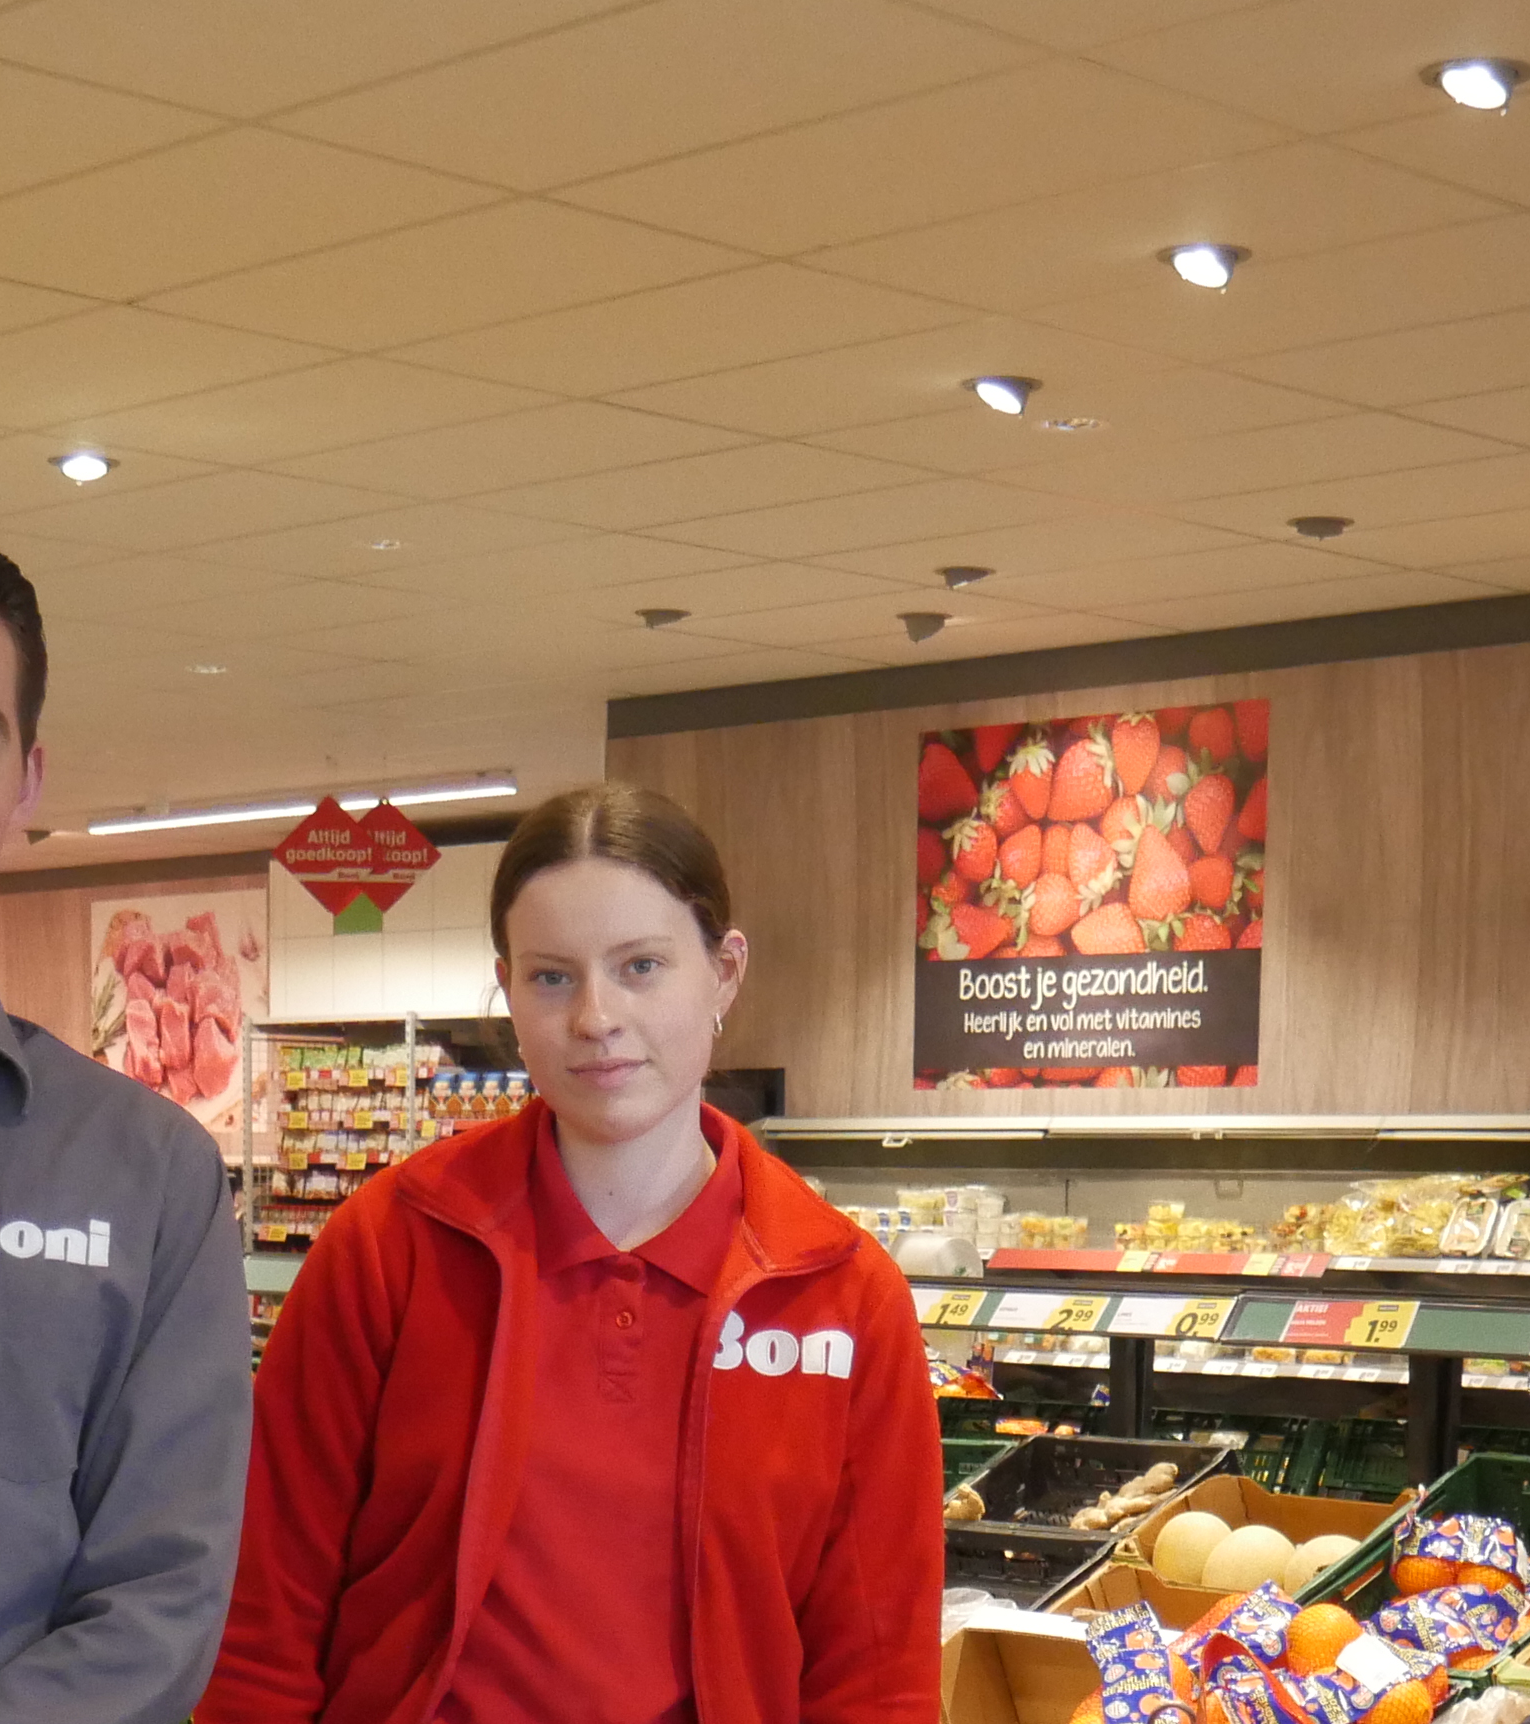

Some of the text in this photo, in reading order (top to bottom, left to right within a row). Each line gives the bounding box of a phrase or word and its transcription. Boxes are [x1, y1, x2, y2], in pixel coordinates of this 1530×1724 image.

[308, 829, 351, 847] Altijd
[368, 830, 406, 847] ltijd
[286, 848, 372, 864] goedkoop!
[959, 960, 1209, 1010] Boost je gezondheid.
[964, 1007, 1201, 1040] Heerlijk en vol met vitamines
[1023, 1037, 1136, 1059] en mineralen.
